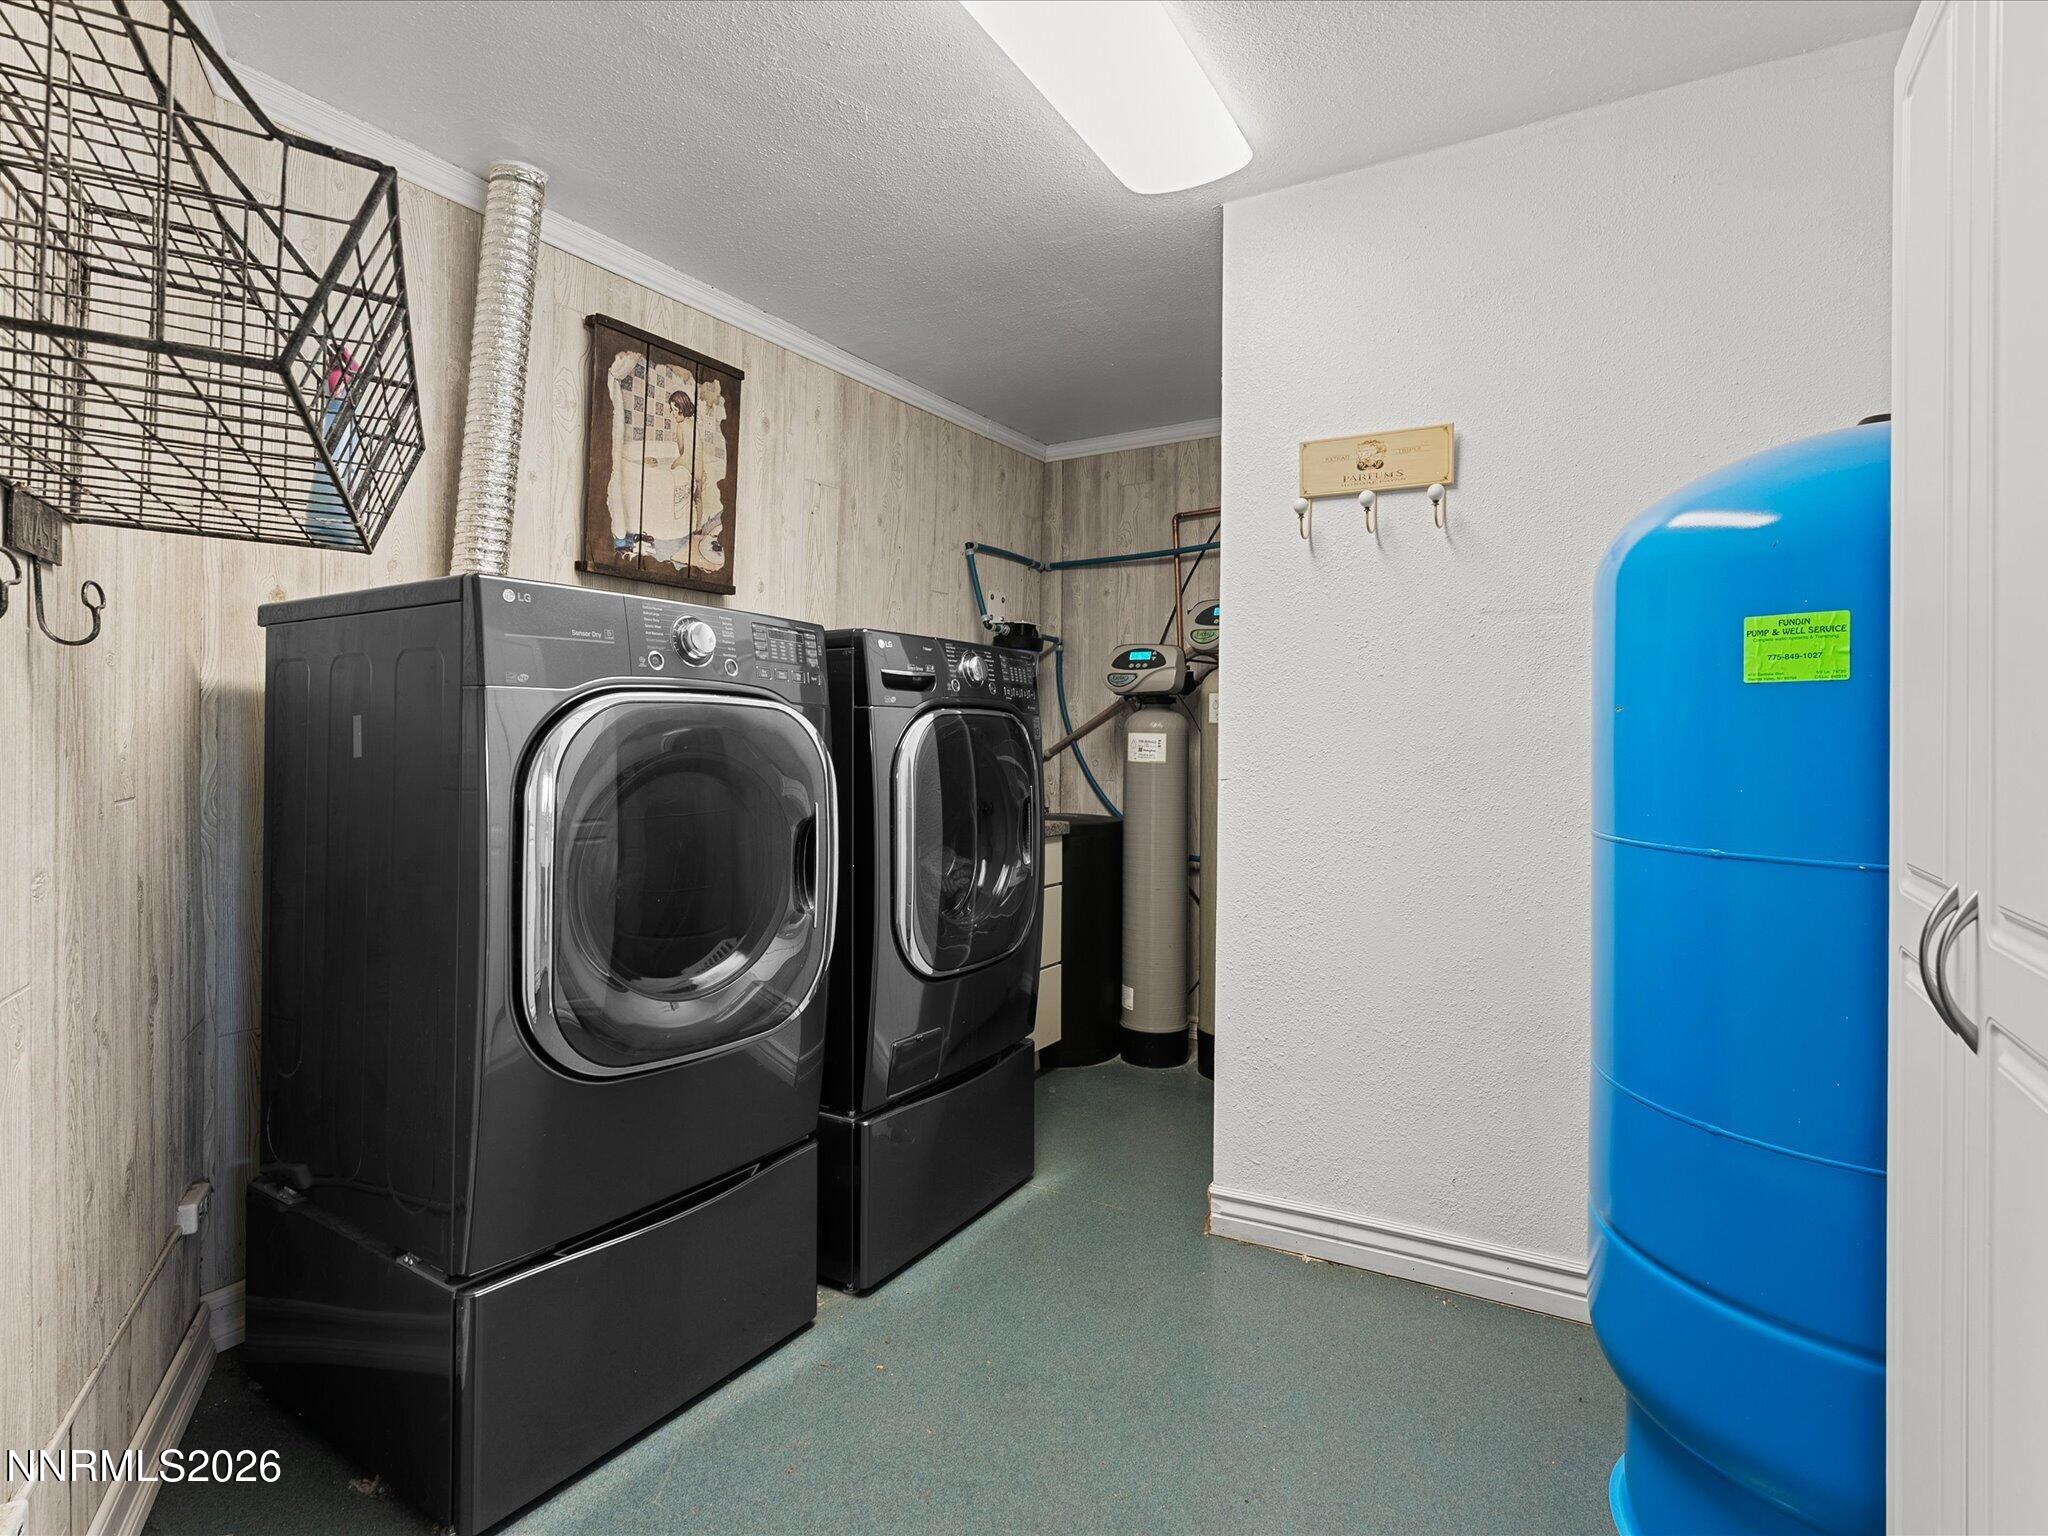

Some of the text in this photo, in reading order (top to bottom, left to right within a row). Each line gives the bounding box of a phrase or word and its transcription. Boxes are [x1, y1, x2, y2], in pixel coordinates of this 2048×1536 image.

[1343, 470, 1405, 483] PARFUMS
[1778, 618, 1811, 627] FUNDIN
[1746, 629, 1770, 637] PUMP
[1782, 627, 1806, 635] WELL
[1808, 625, 1847, 634] SERVICE
[1767, 652, 1823, 661] 775-849-1027
